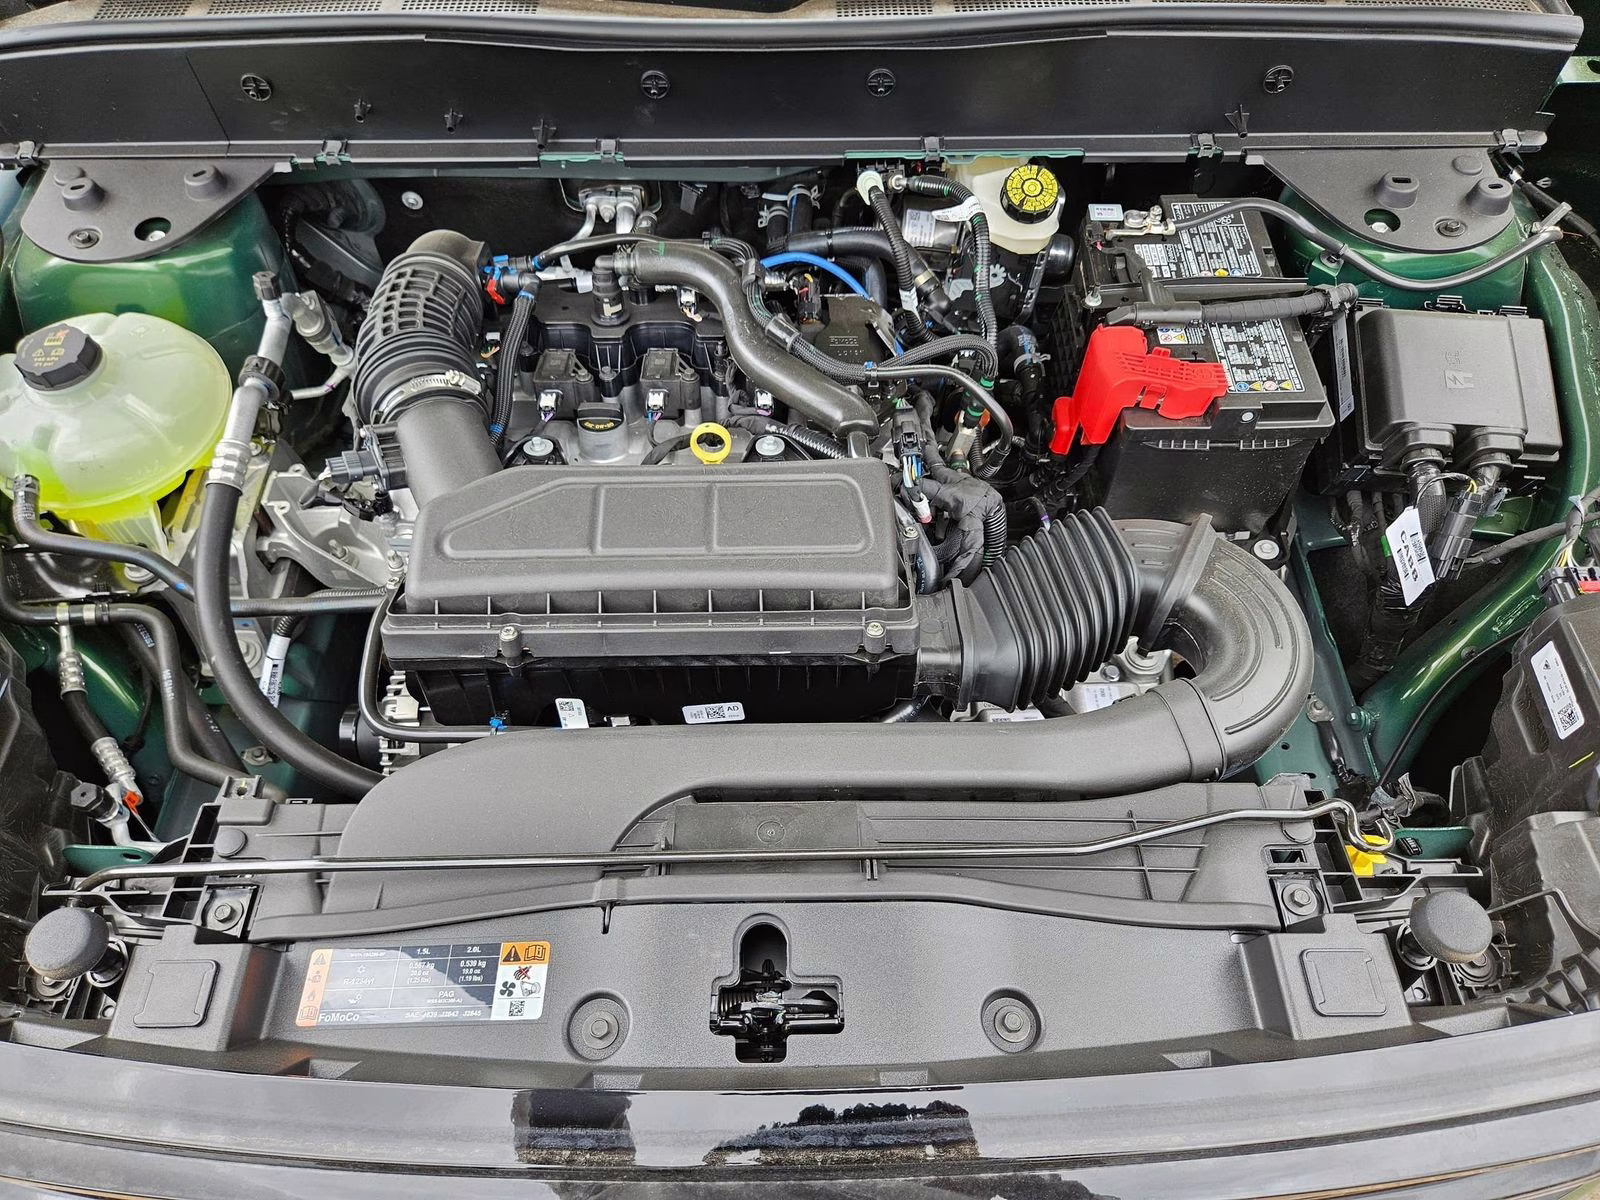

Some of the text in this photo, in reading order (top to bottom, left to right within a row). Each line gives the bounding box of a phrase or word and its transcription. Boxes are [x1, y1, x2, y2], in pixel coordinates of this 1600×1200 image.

[416, 947, 431, 955] 1.5L
[477, 959, 487, 968] kg
[438, 990, 455, 998] PAG
[318, 1012, 360, 1023] FoMoCo
